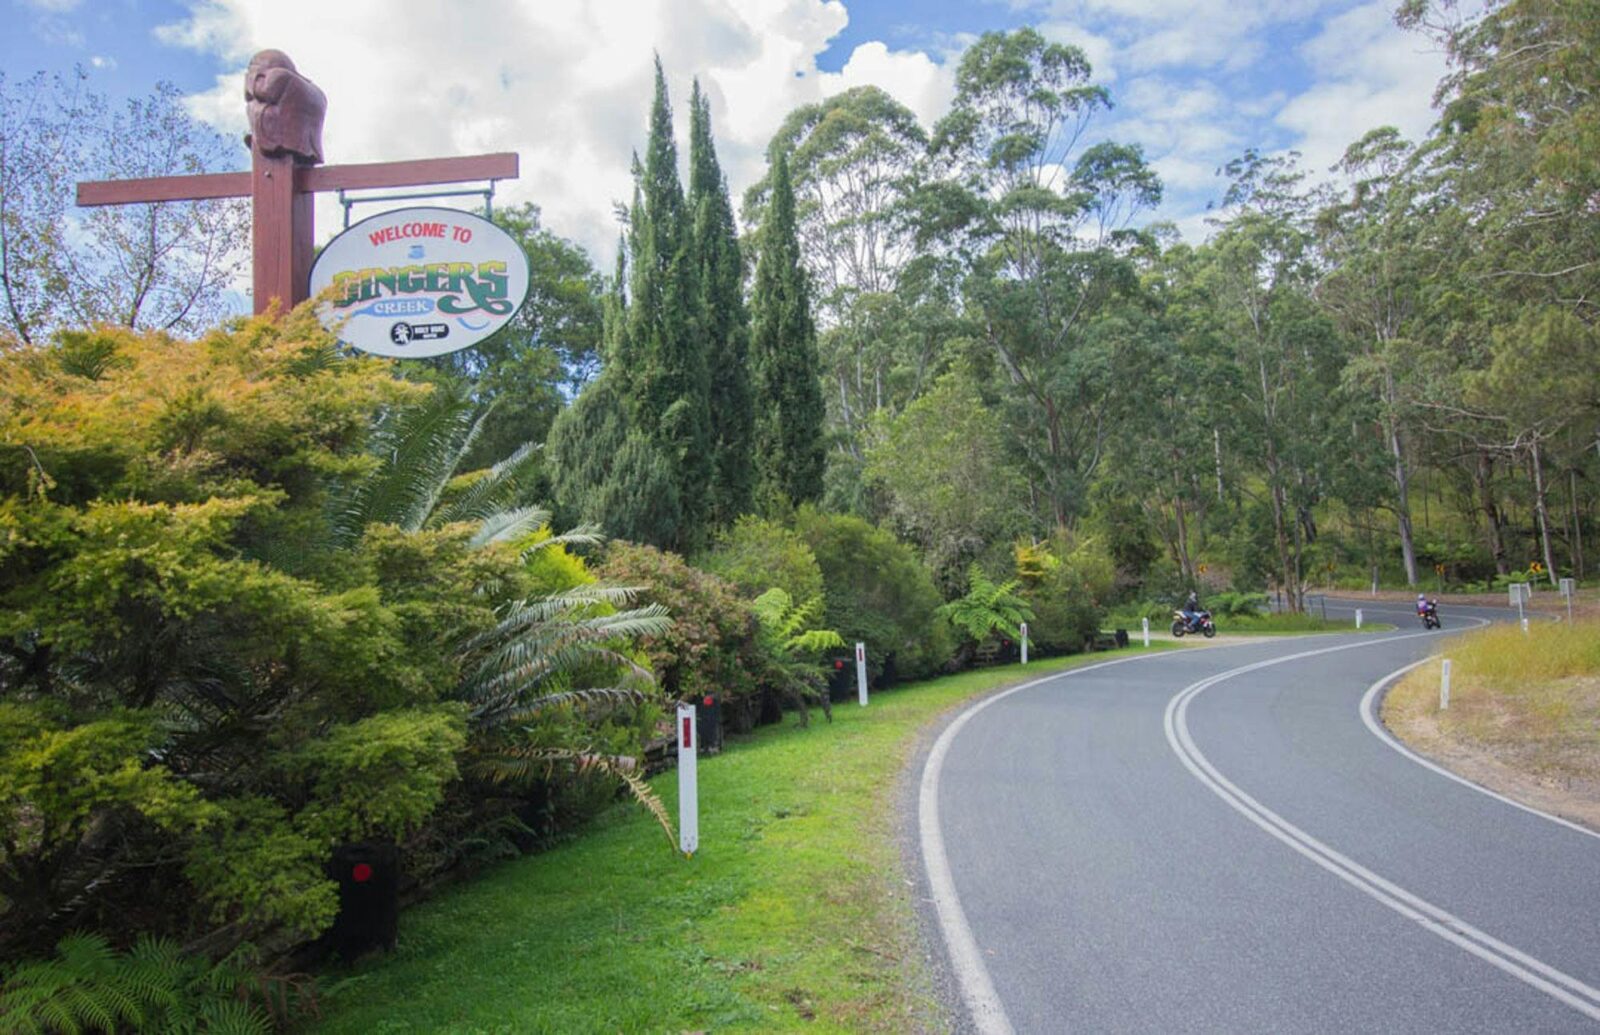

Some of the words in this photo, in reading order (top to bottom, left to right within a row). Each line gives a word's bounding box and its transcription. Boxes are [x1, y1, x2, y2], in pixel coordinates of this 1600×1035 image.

[368, 222, 448, 247] WELCOME
[452, 225, 473, 244] TO
[333, 261, 514, 315] GINGERS
[374, 299, 430, 314] CREEK
